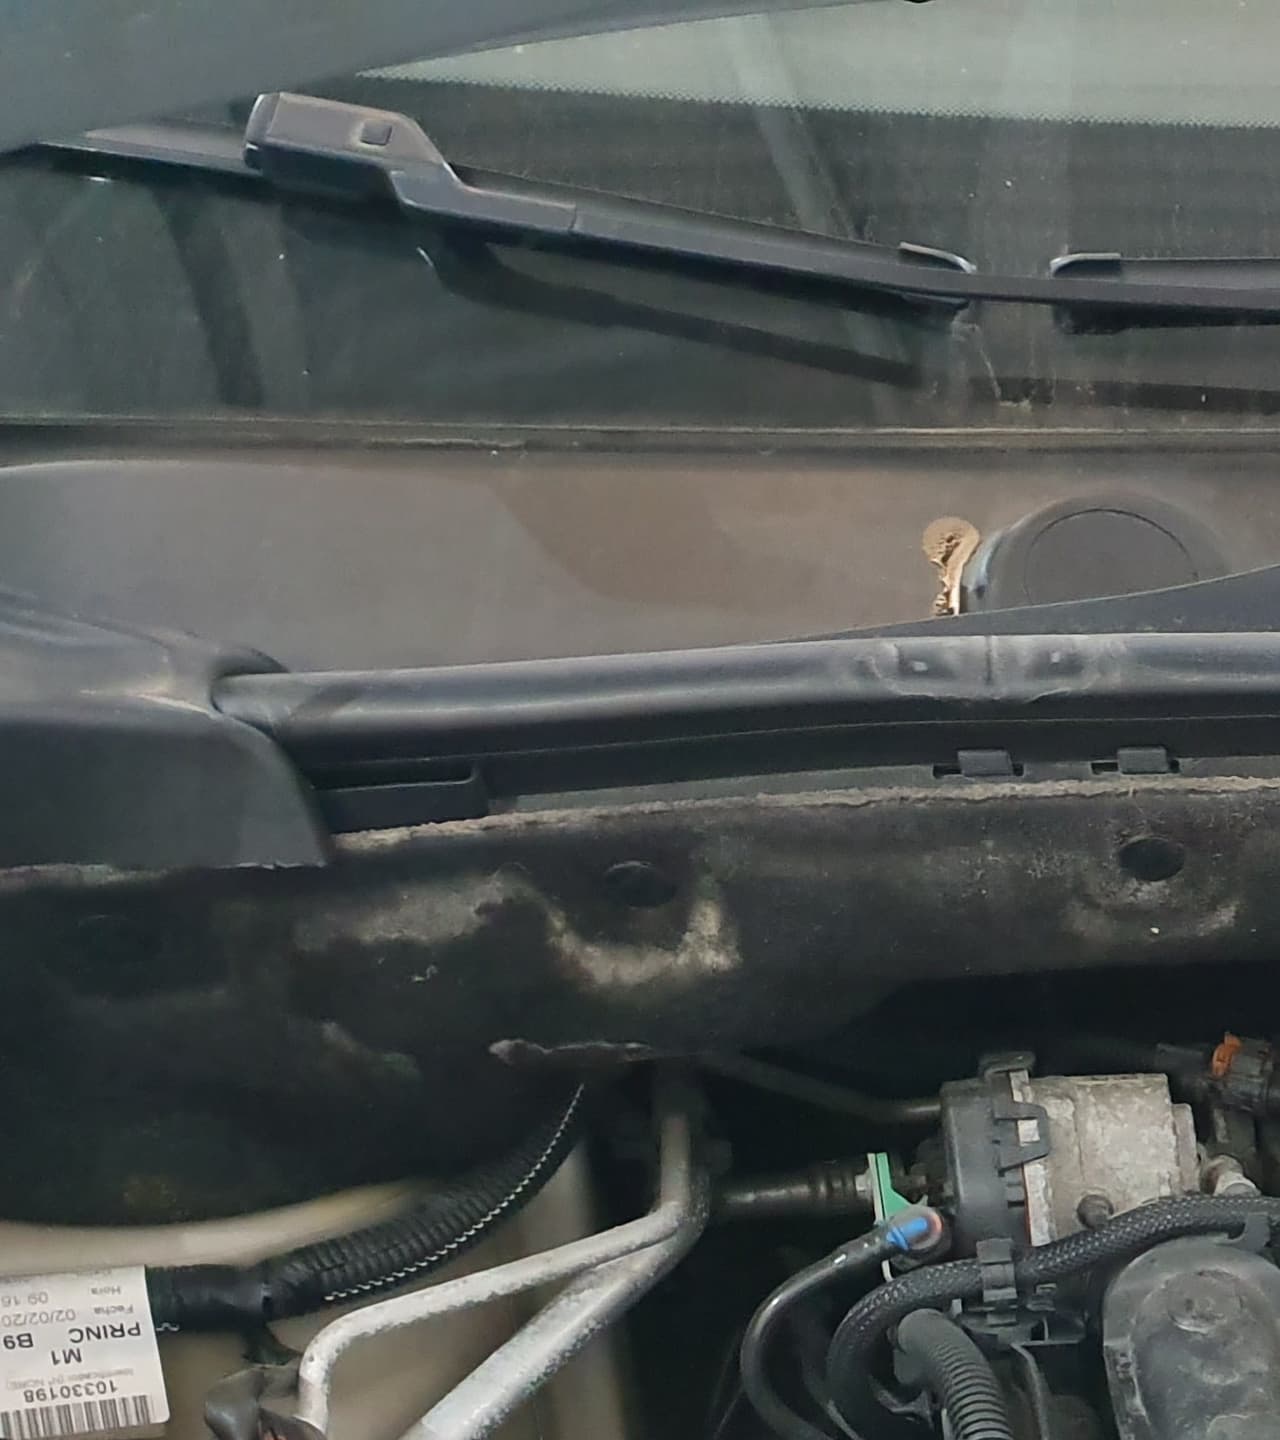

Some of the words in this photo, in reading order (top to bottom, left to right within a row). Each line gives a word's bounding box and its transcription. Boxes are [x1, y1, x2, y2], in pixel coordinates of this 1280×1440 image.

[93, 1304, 134, 1317] Fecha
[67, 1321, 142, 1344] PRINC
[49, 1347, 82, 1366] M1
[24, 1379, 118, 1403] 10330198
